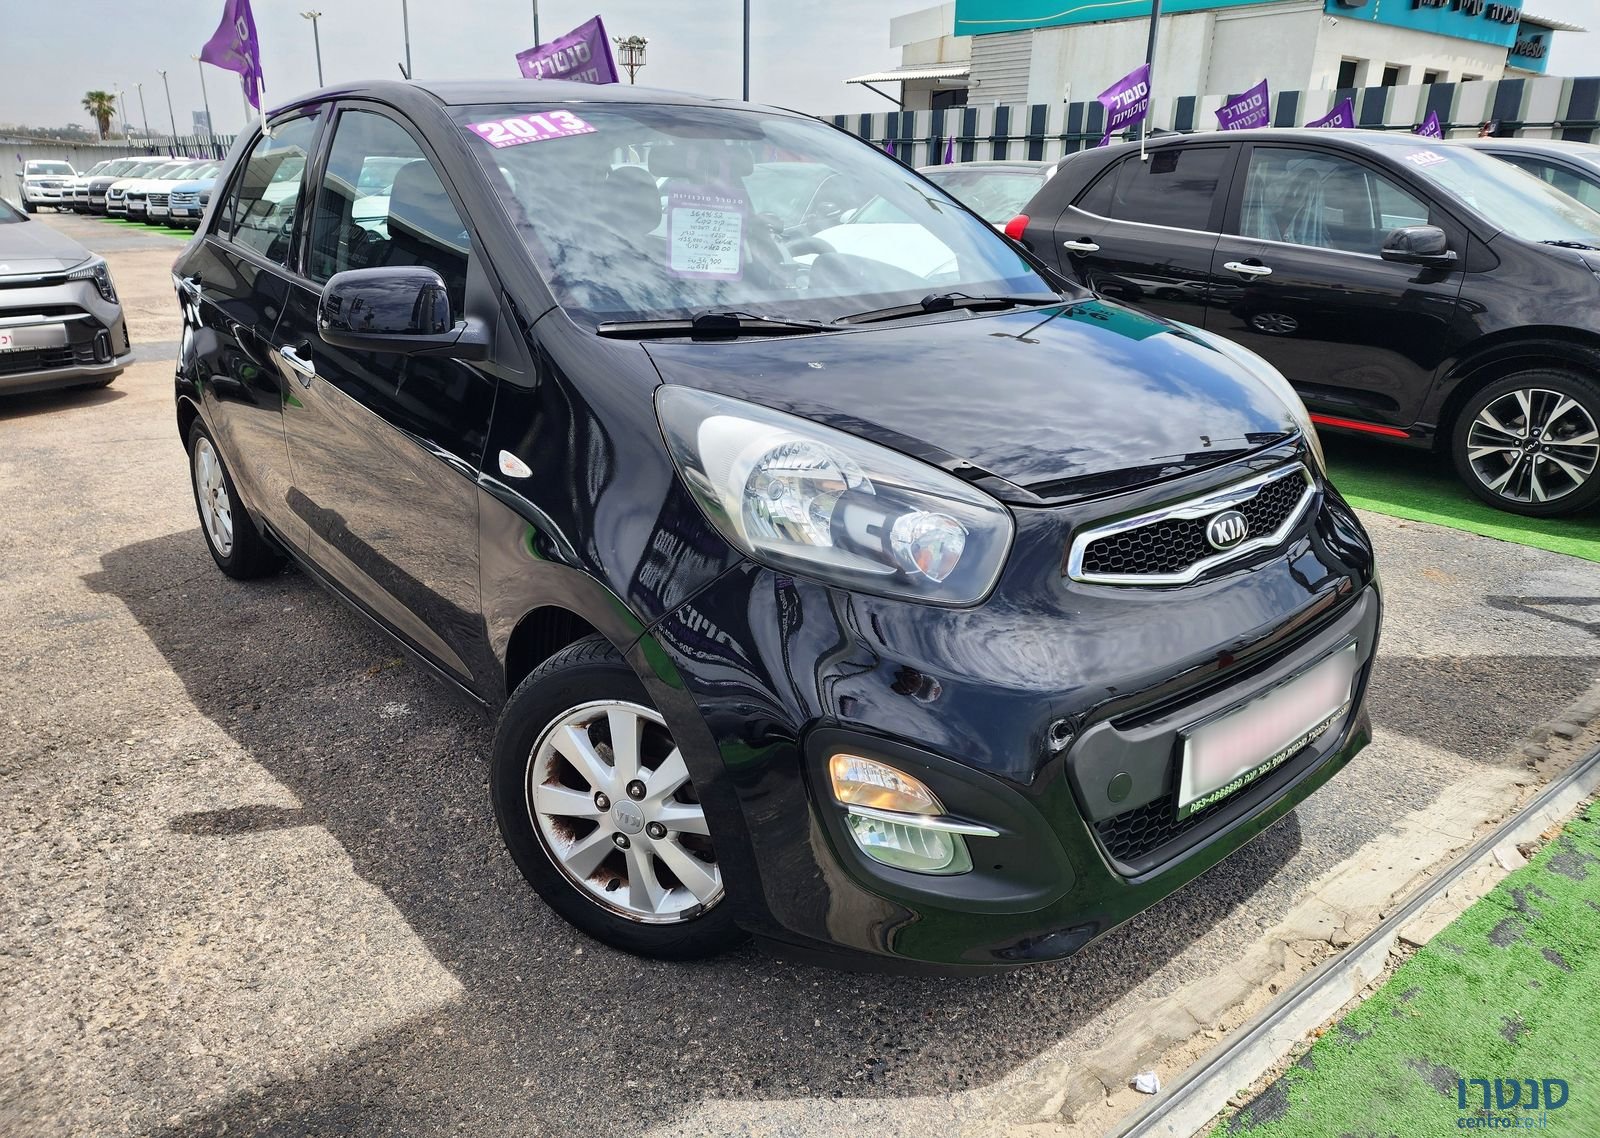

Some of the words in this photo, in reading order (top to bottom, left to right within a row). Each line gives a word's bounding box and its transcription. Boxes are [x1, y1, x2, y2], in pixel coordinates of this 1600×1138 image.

[529, 42, 591, 80] סנטרל
[1111, 81, 1148, 109] סנטרל
[1222, 93, 1263, 119] סנטרל
[1111, 98, 1148, 126] סוכנויות
[476, 111, 585, 142] 2013
[1213, 516, 1246, 544] KIA
